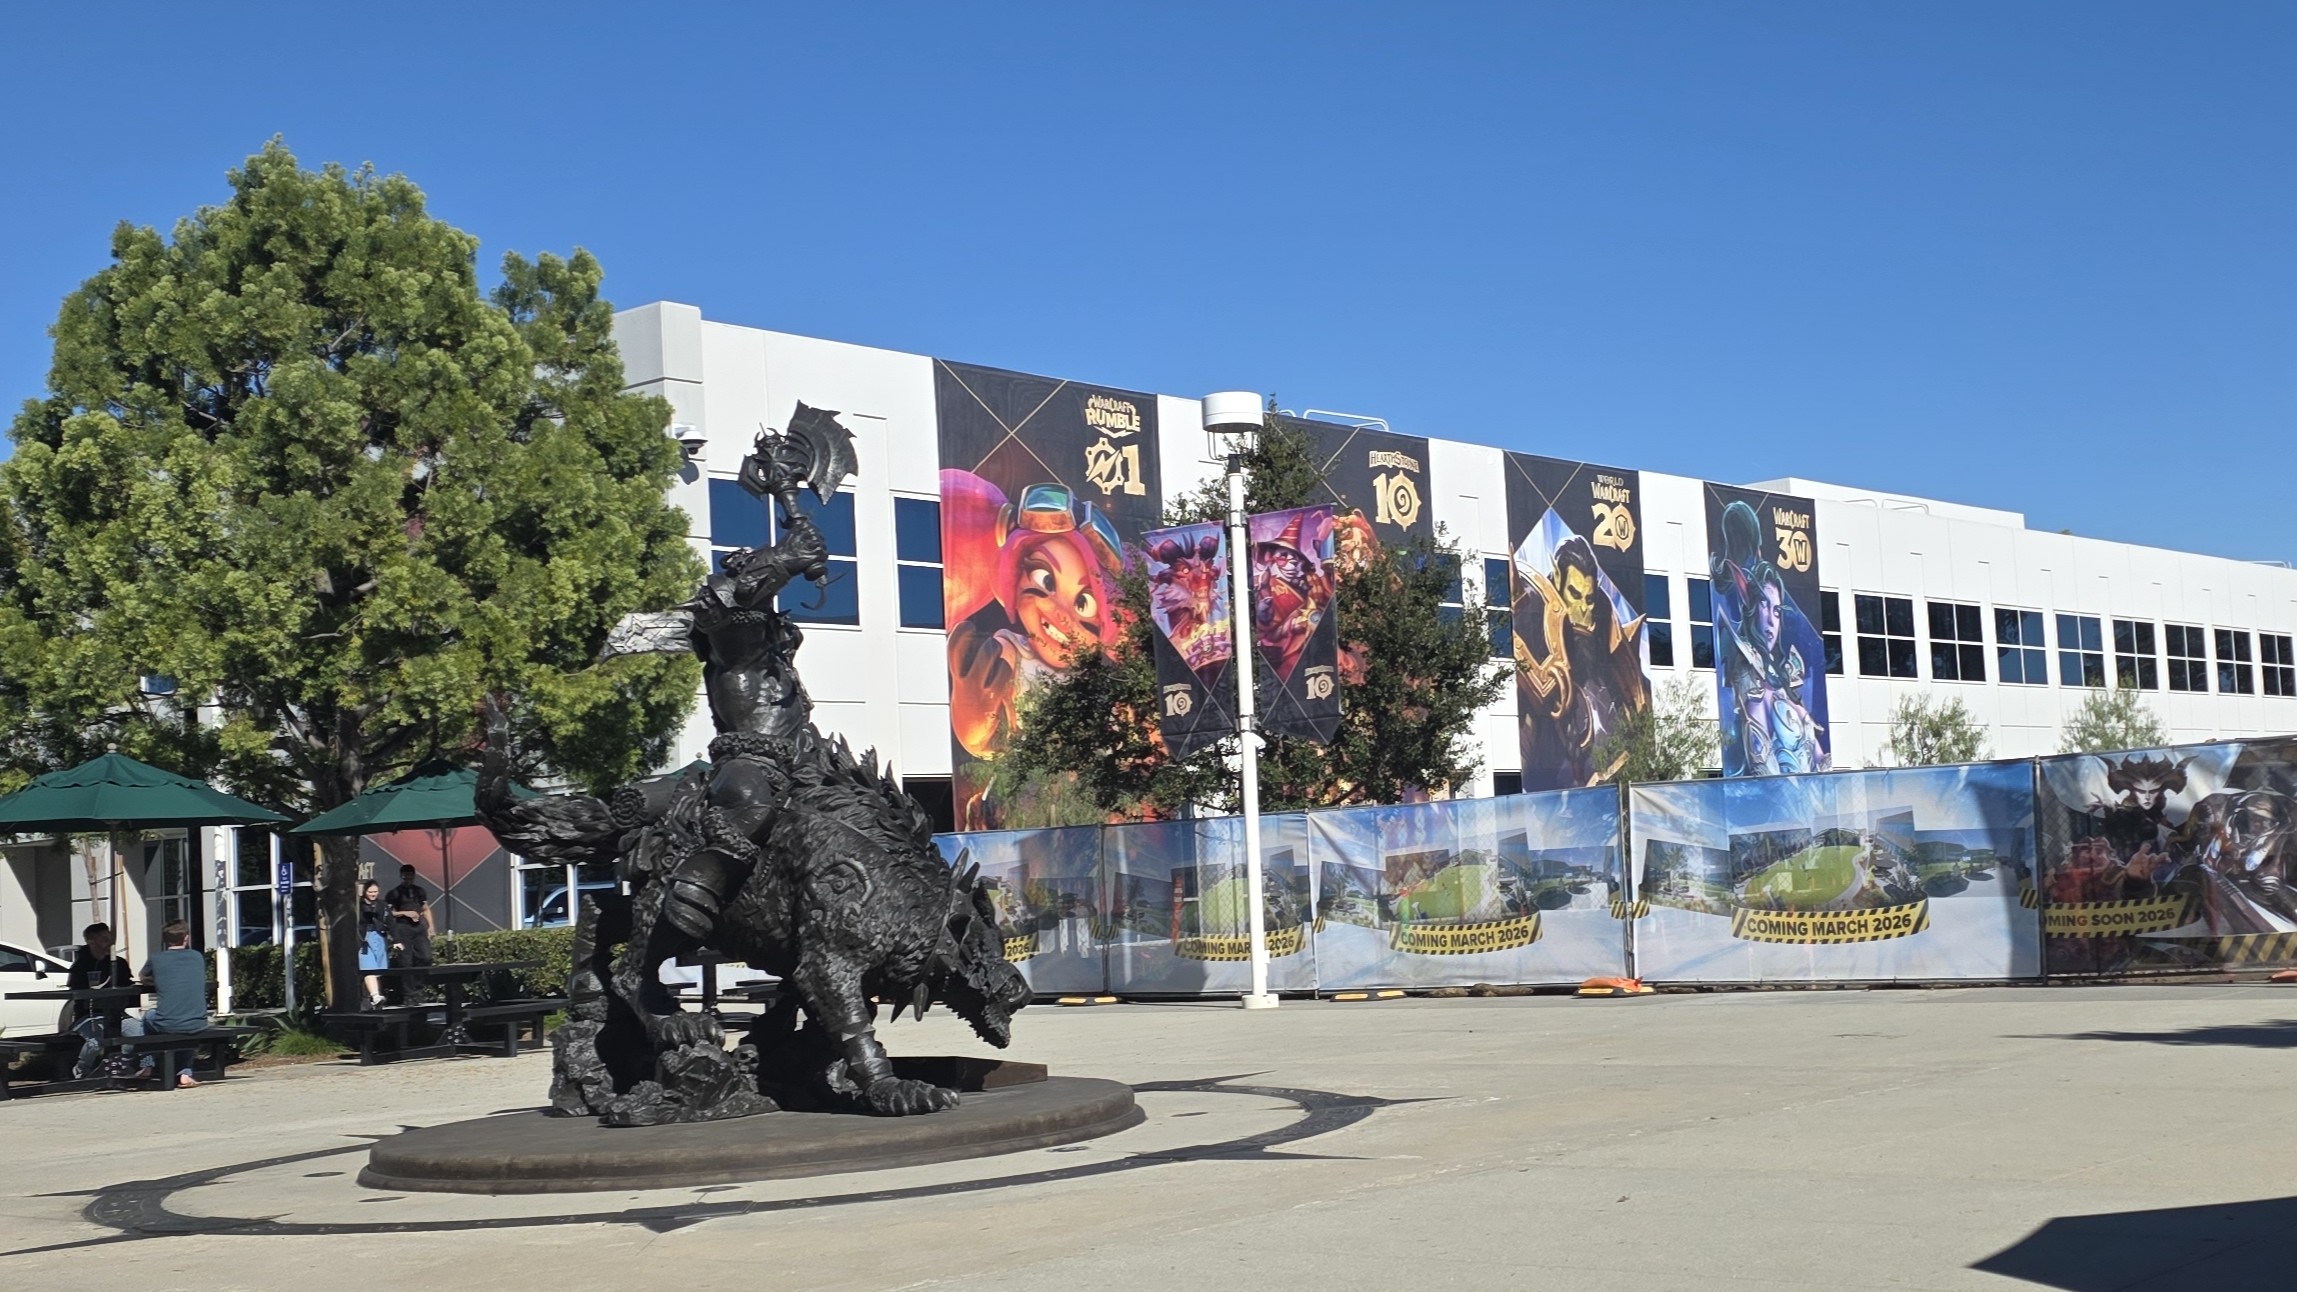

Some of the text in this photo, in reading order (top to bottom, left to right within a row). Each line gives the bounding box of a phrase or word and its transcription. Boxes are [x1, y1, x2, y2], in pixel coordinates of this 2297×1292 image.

[1085, 408, 1141, 432] RUMBLE
[1597, 474, 1624, 487] WORLD
[1373, 470, 1422, 532] 10
[1591, 503, 1636, 552] 20
[1775, 527, 1812, 573] 30
[1306, 673, 1335, 701] 10
[1164, 691, 1193, 717] 10
[1747, 913, 1912, 937] COMING MARCH 2026
[2091, 913, 2134, 926] SOON
[2138, 908, 2175, 923] 2026
[1183, 936, 1295, 955] COMING MAR 2026
[1401, 925, 1529, 948] COMING MARCH 2026
[1006, 943, 1030, 957] 2026
